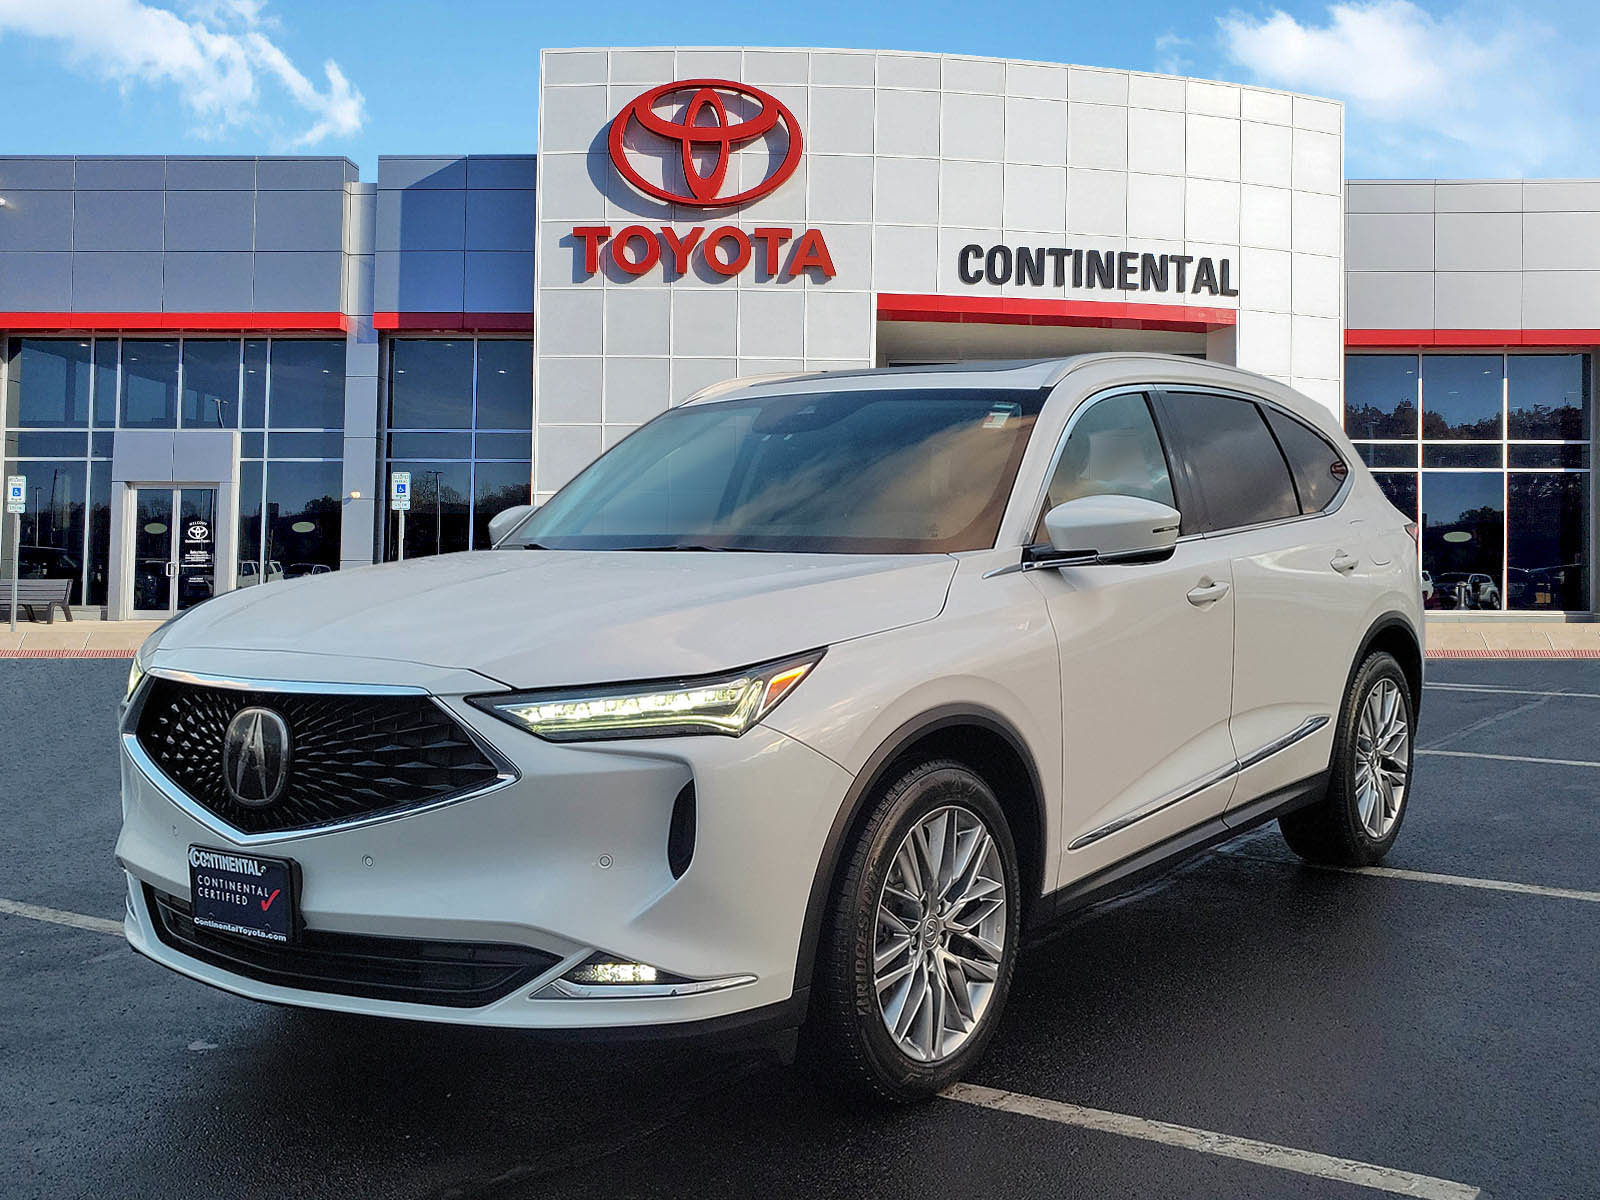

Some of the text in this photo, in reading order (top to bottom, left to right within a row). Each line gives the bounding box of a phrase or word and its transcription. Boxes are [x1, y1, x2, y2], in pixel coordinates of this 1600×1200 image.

[572, 225, 836, 276] TOYOTA
[958, 244, 1239, 296] CONTINENTAL
[190, 848, 262, 876] CONTINENTAL
[197, 875, 269, 897] CONTINENTAL
[198, 887, 248, 905] CERTIFIED
[194, 917, 287, 942] ContinentalToyota.com
